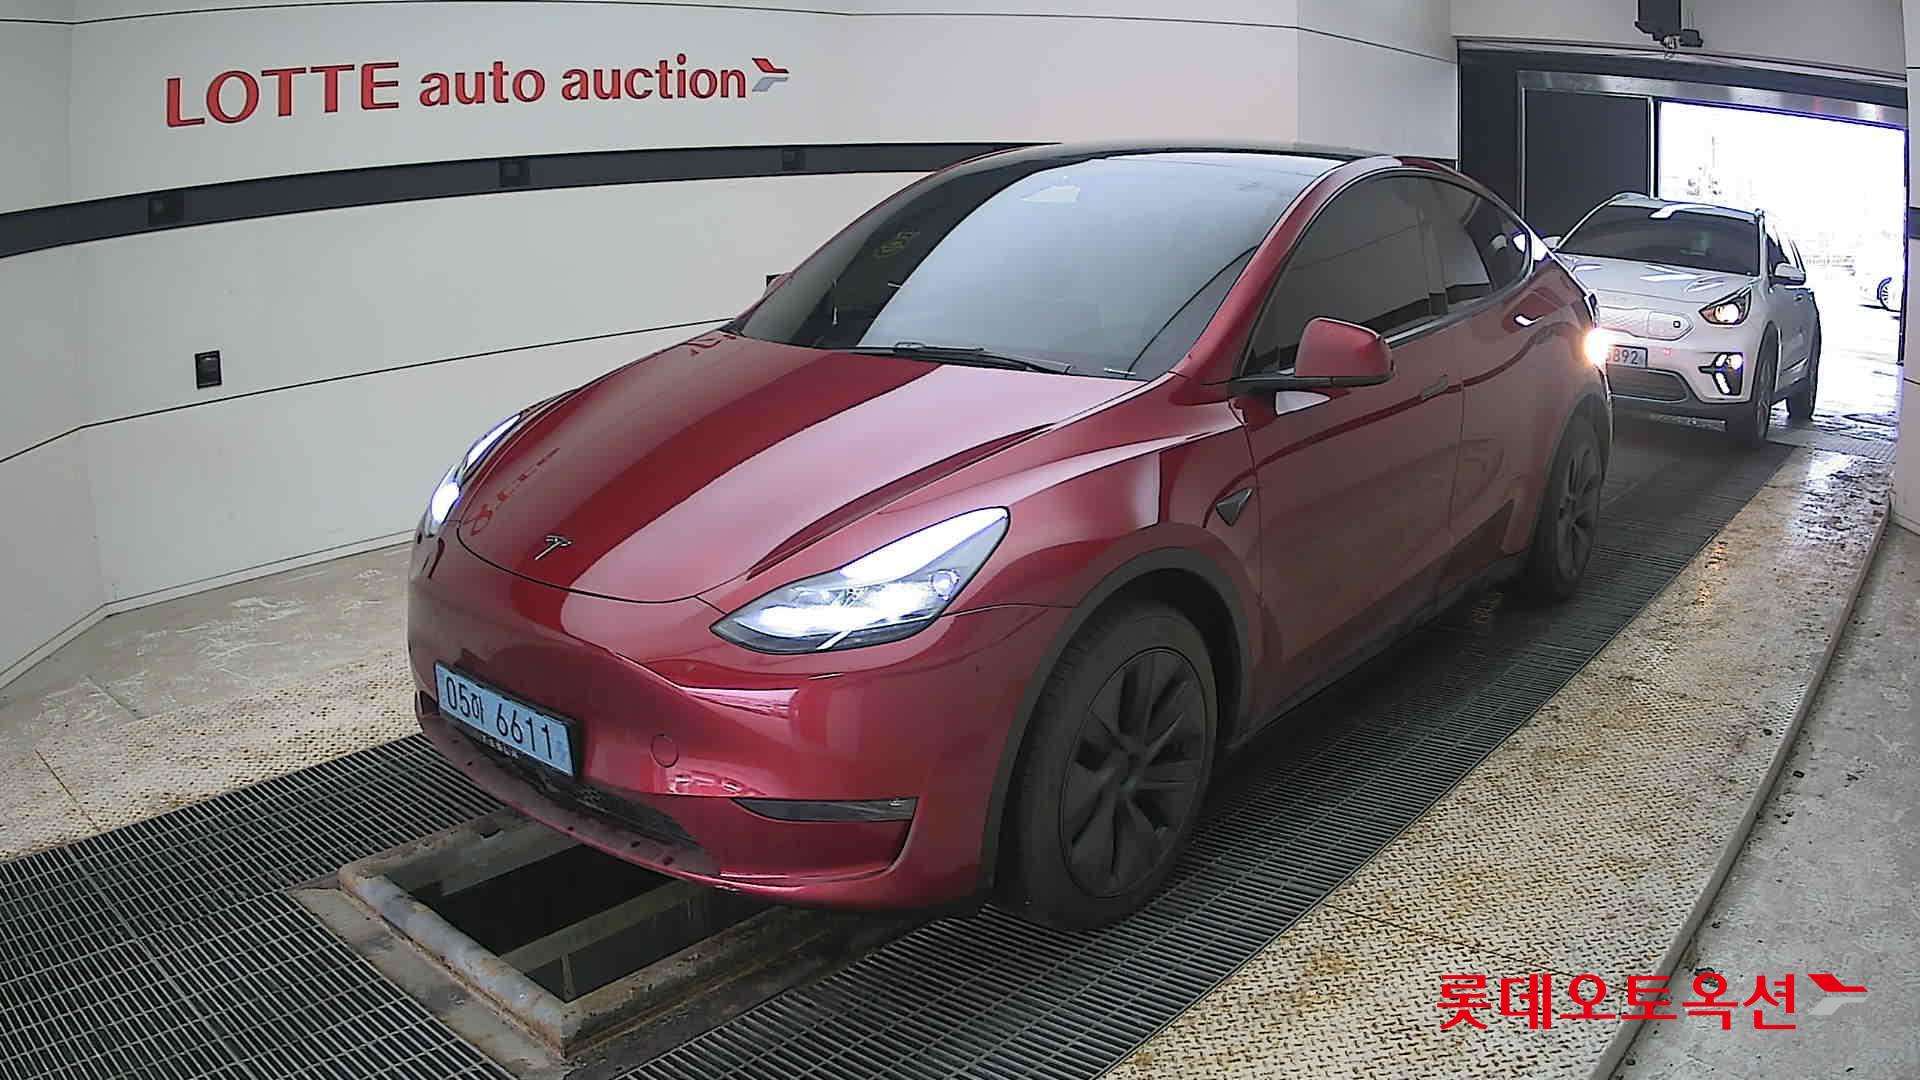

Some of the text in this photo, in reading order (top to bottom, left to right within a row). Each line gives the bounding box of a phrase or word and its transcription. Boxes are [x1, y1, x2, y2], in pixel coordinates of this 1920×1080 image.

[166, 52, 748, 127] LOTTE auto auction
[496, 703, 553, 760] 6611
